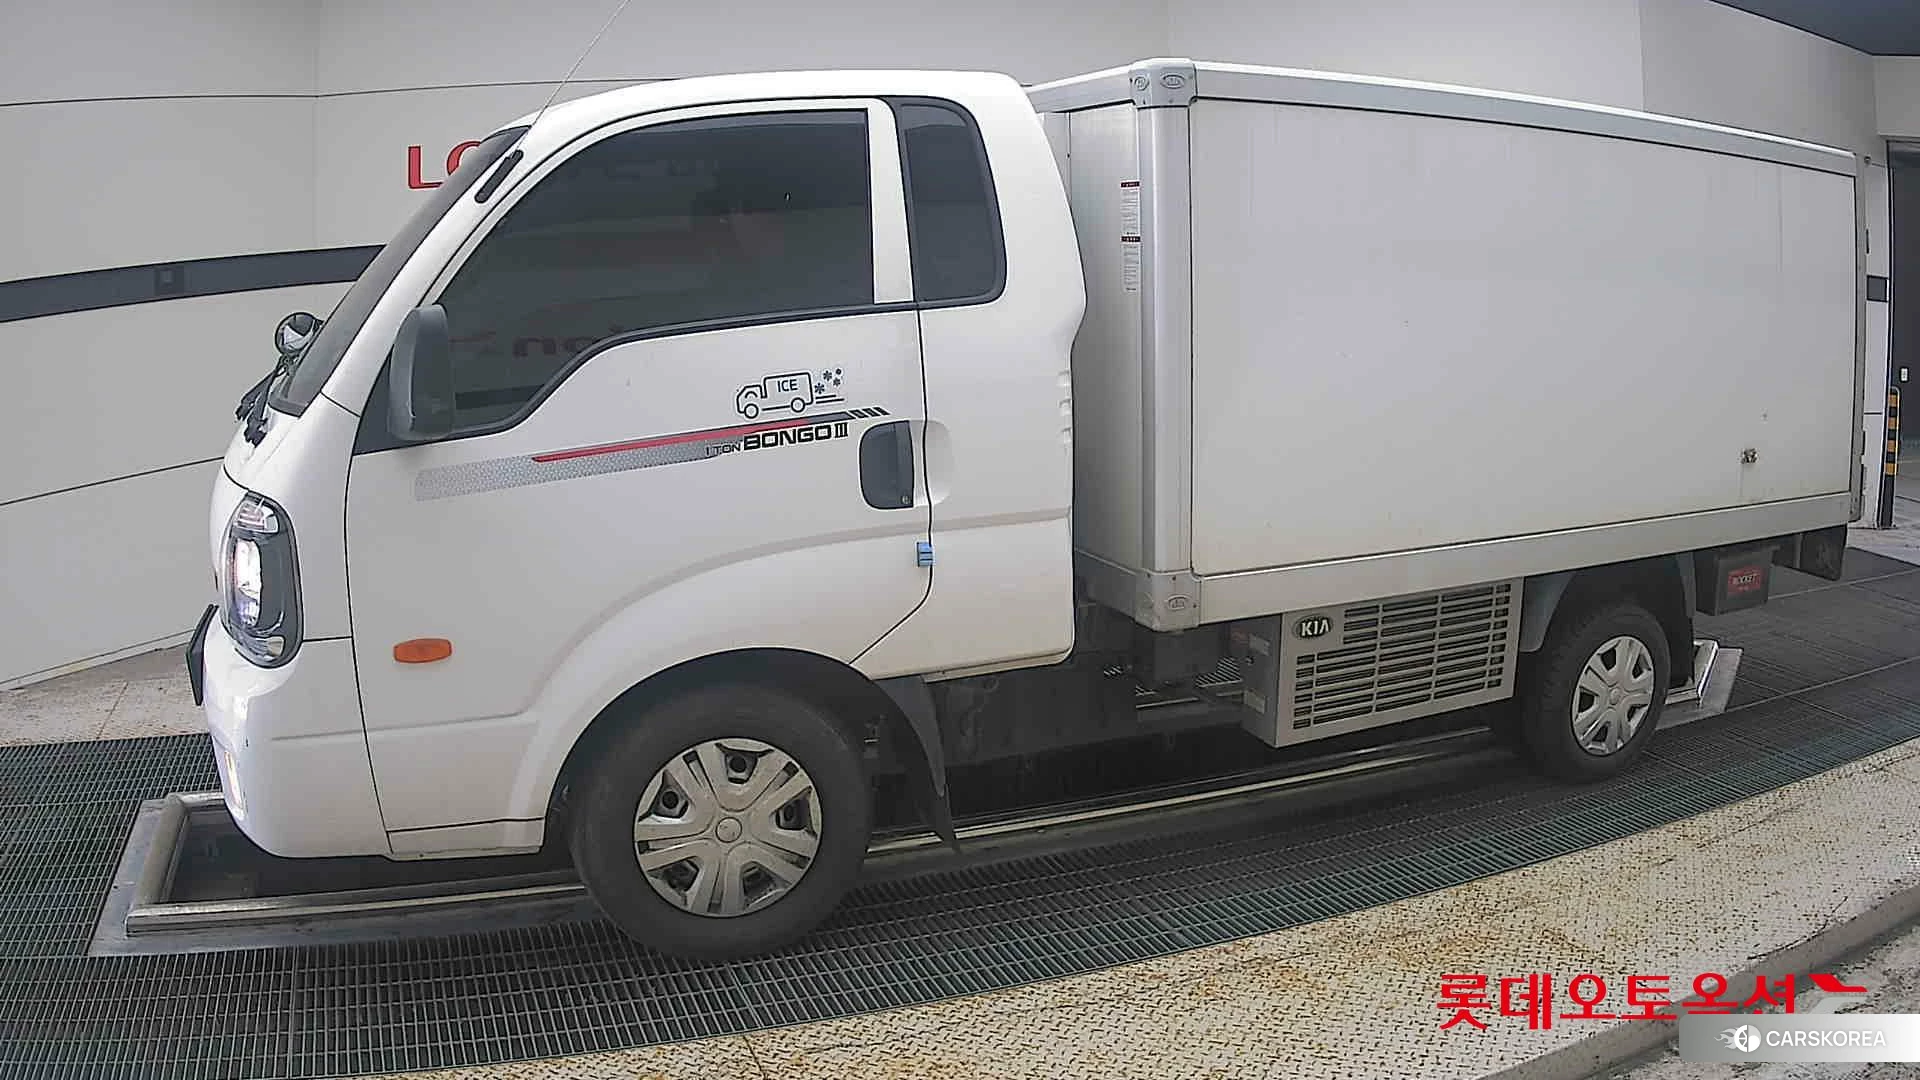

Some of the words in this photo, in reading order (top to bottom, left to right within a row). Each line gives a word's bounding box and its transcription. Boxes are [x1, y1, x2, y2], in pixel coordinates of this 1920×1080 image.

[777, 379, 799, 393] ICE
[713, 443, 742, 455] TON
[744, 425, 832, 450] BONGO
[1301, 619, 1330, 637] KIA
